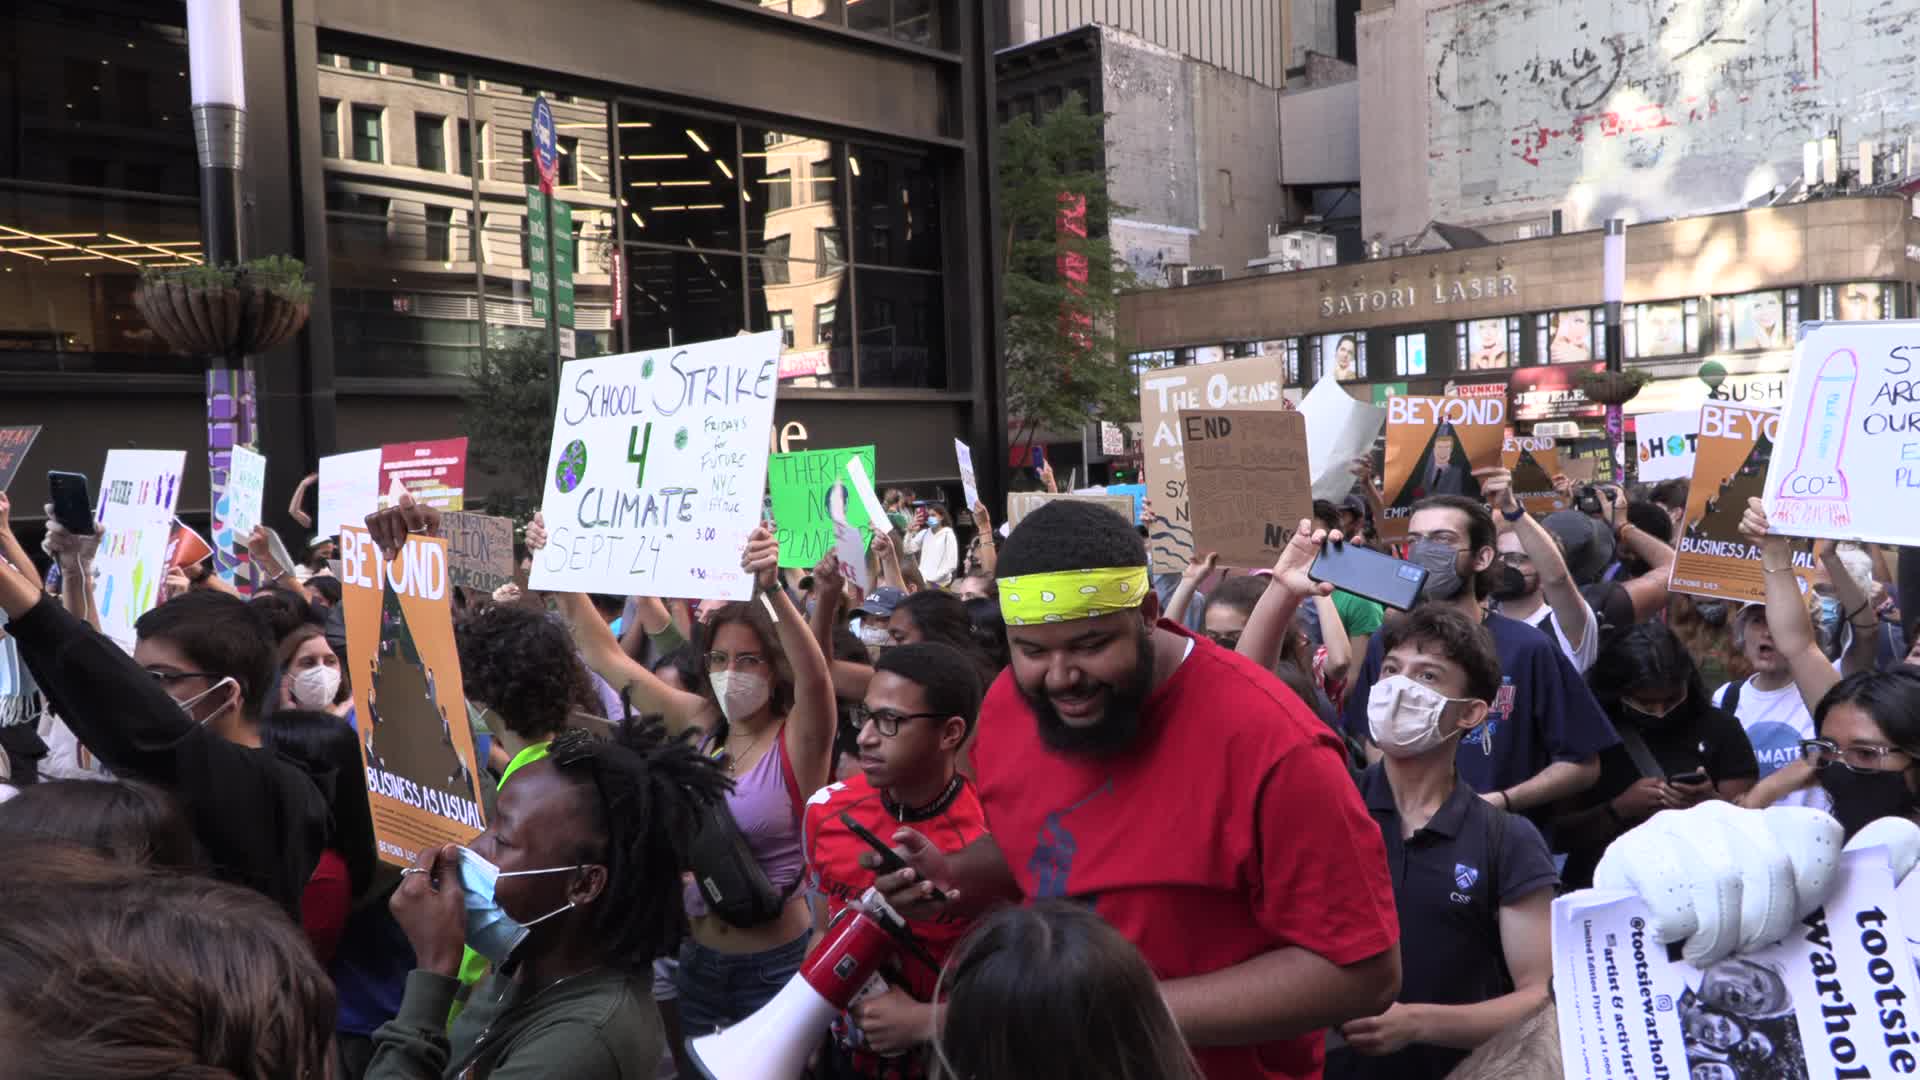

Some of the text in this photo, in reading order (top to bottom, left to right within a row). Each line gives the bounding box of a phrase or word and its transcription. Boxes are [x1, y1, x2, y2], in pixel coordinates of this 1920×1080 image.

[1321, 274, 1517, 317] SATORI LASER
[564, 350, 776, 426] SCHOOL STRIKE
[1145, 373, 1280, 413] THE OCEANS
[1388, 396, 1504, 424] BEYOND
[1716, 381, 1783, 401] SUSH
[1185, 415, 1232, 441] END
[627, 422, 653, 489] 4
[577, 487, 698, 528] CLIMATE
[341, 528, 446, 601] BEYOND
[544, 526, 624, 577] SEPT
[1680, 537, 1744, 560] BUSINESS
[366, 766, 422, 809] BUSINESS
[422, 785, 440, 816] AS
[439, 790, 486, 833] USUAL
[1604, 947, 1619, 992] artist
[1801, 903, 1872, 1080] warhol
[1856, 905, 1920, 1074] tootsie
